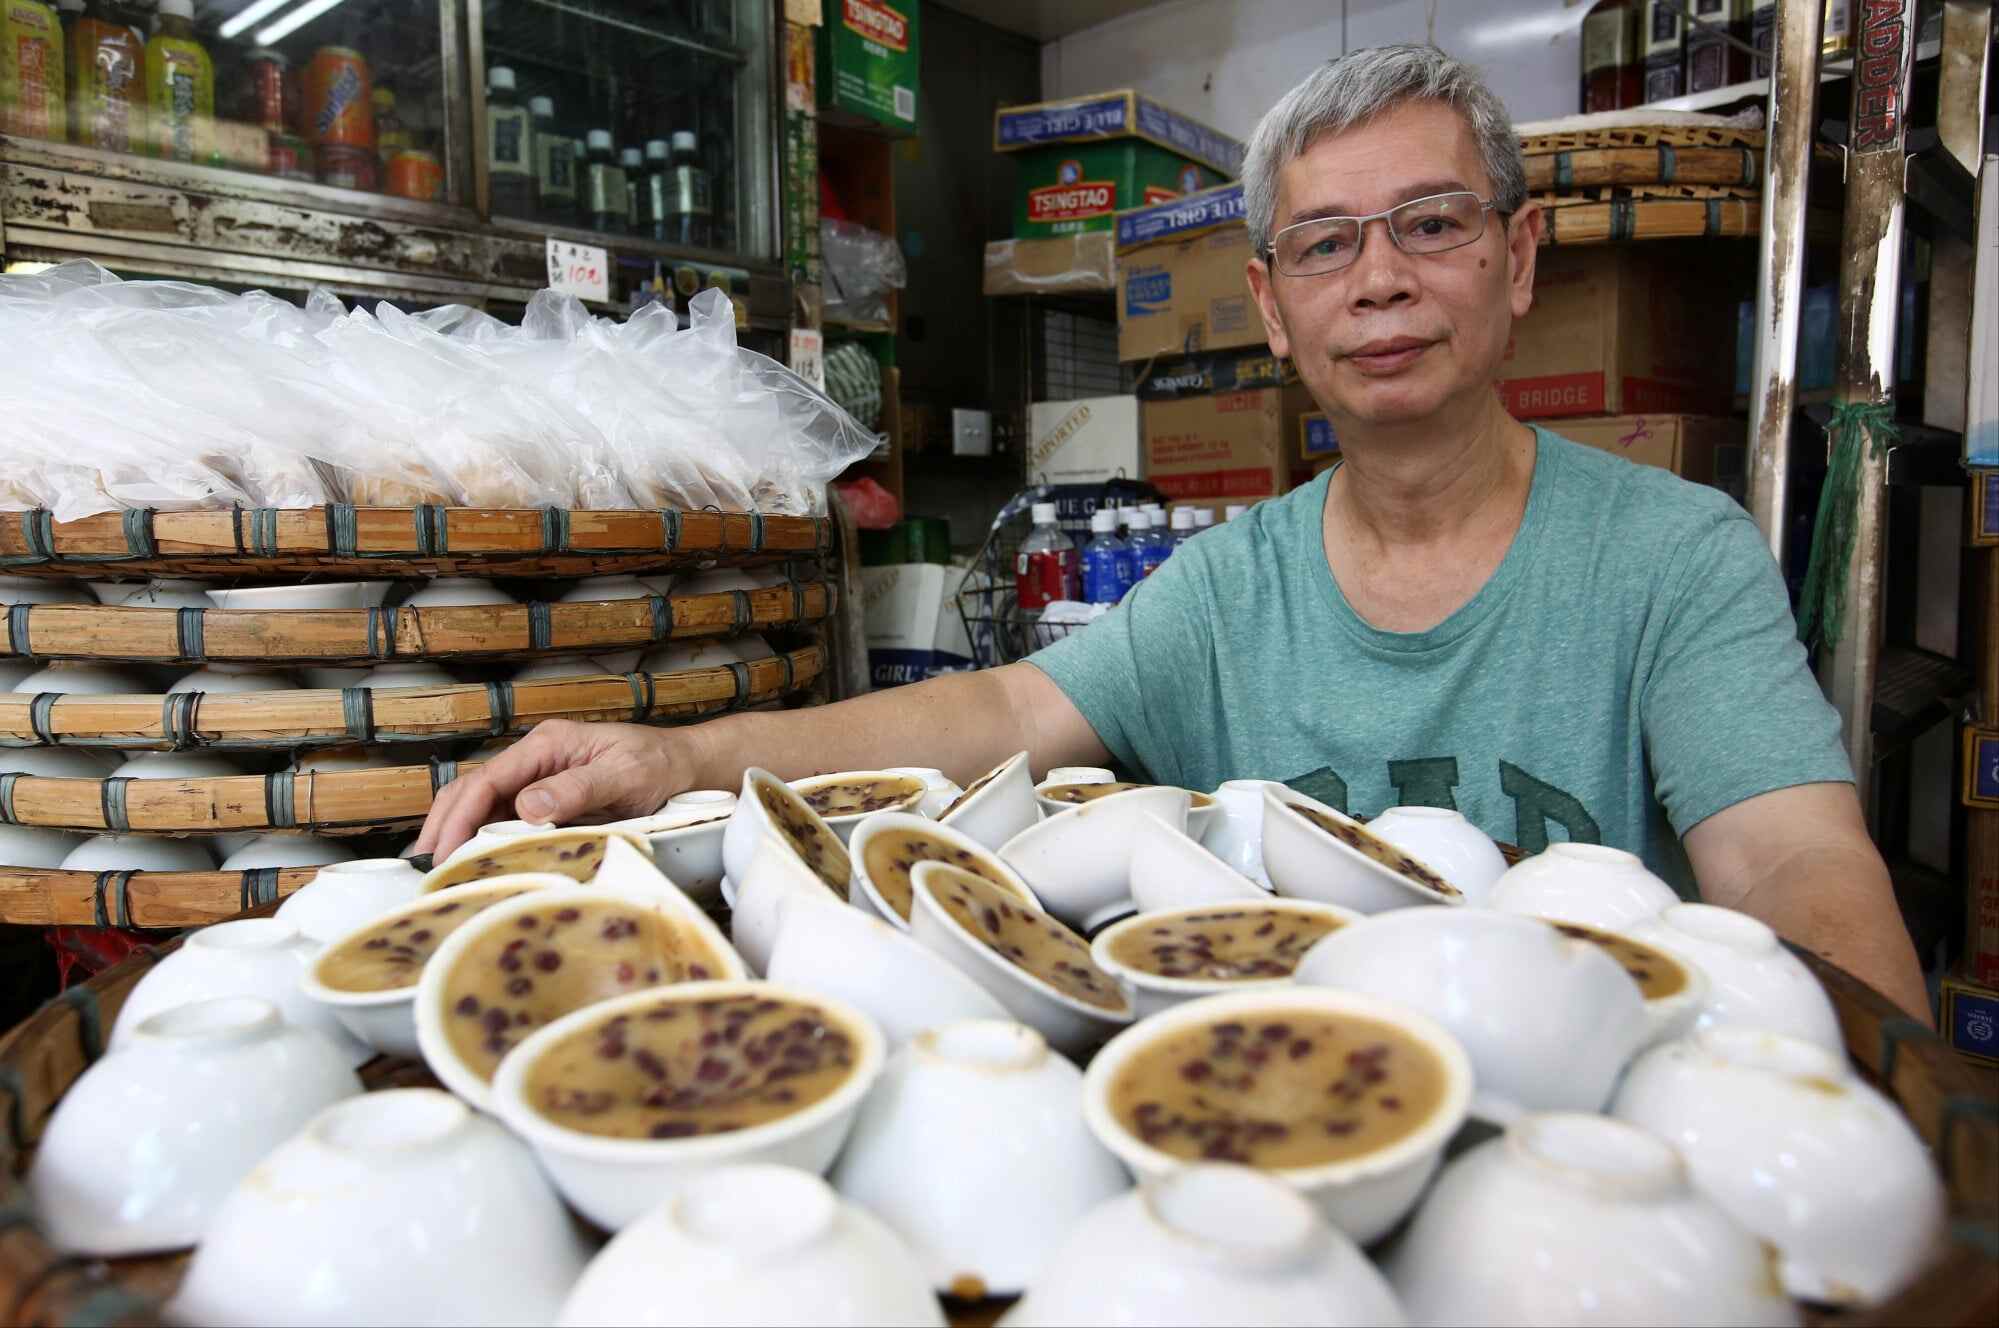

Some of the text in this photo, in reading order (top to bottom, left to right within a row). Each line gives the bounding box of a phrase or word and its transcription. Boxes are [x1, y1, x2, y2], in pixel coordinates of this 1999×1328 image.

[1034, 188, 1108, 212] TSINGTAO
[1213, 196, 1247, 217] LUE
[1168, 206, 1207, 229] GIRL
[1519, 385, 1588, 409] BRIDGE
[1083, 497, 1123, 515] GR
